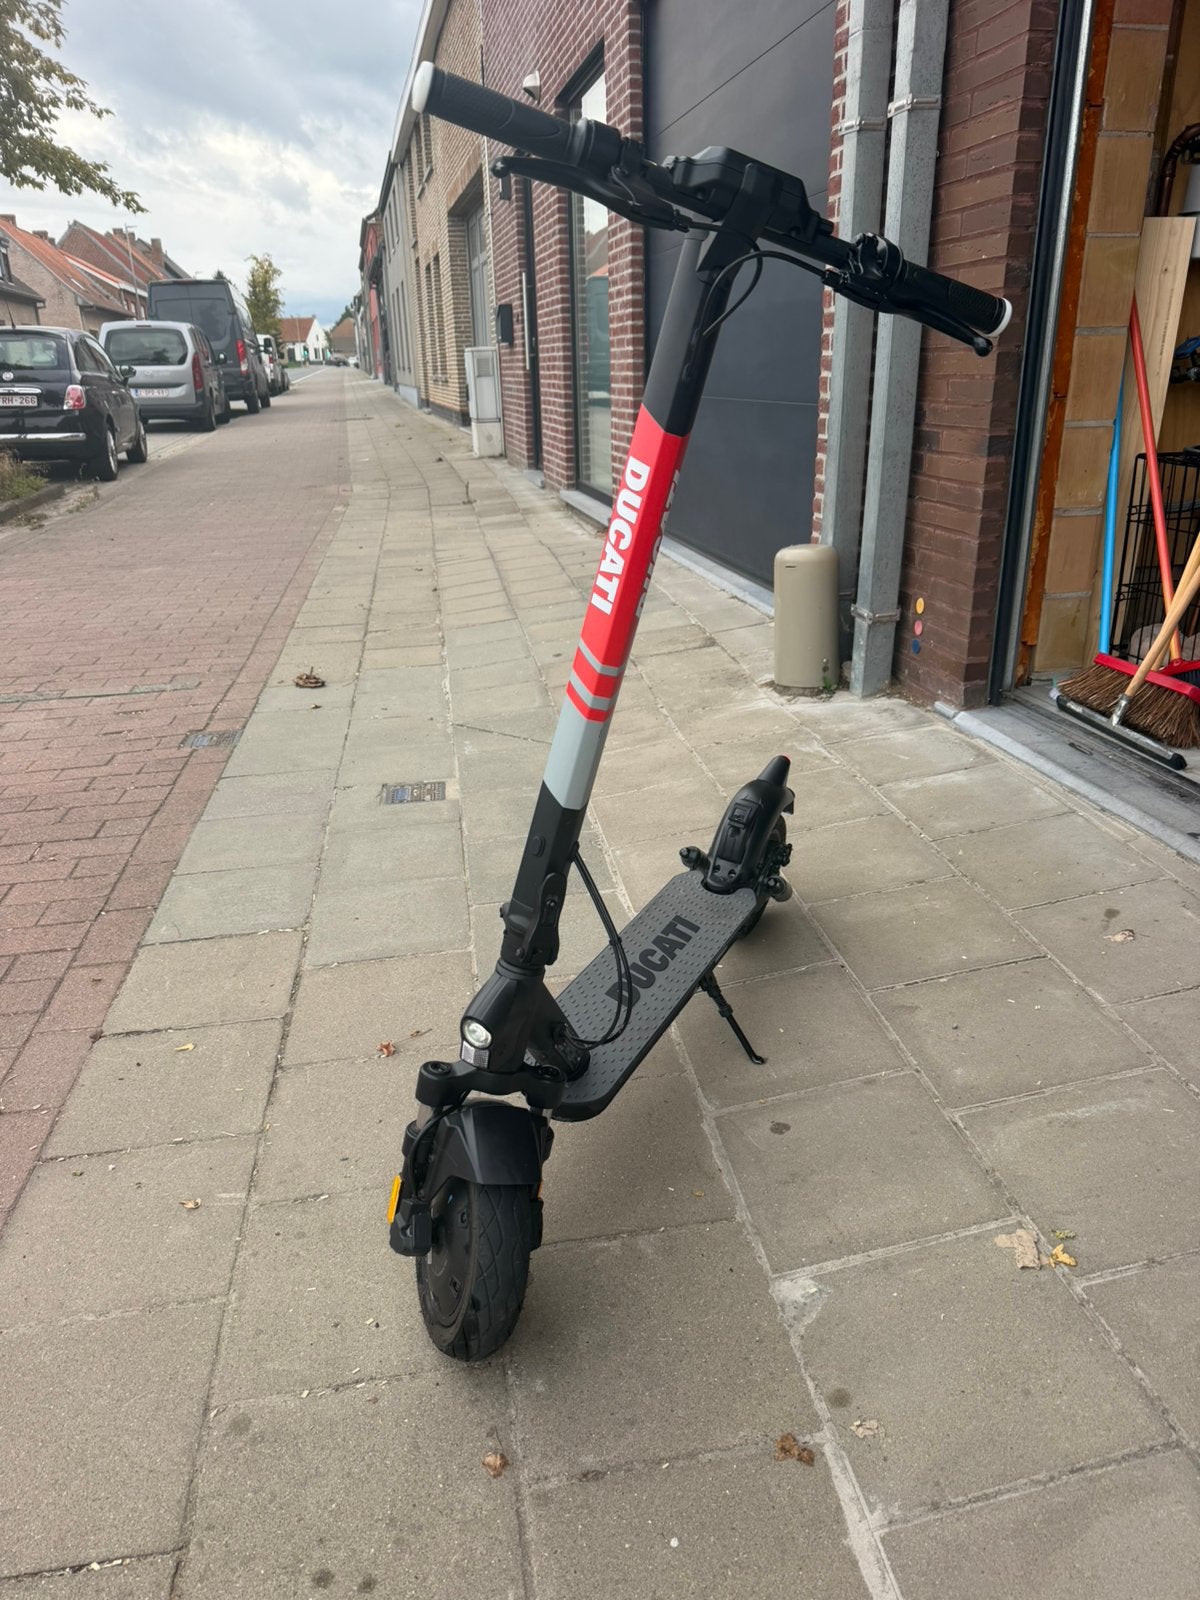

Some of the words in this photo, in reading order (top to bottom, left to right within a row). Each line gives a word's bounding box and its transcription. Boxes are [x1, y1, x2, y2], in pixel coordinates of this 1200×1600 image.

[0, 396, 36, 404] RH-266
[591, 456, 650, 615] DUCATI
[605, 915, 700, 1008] DUCATI
